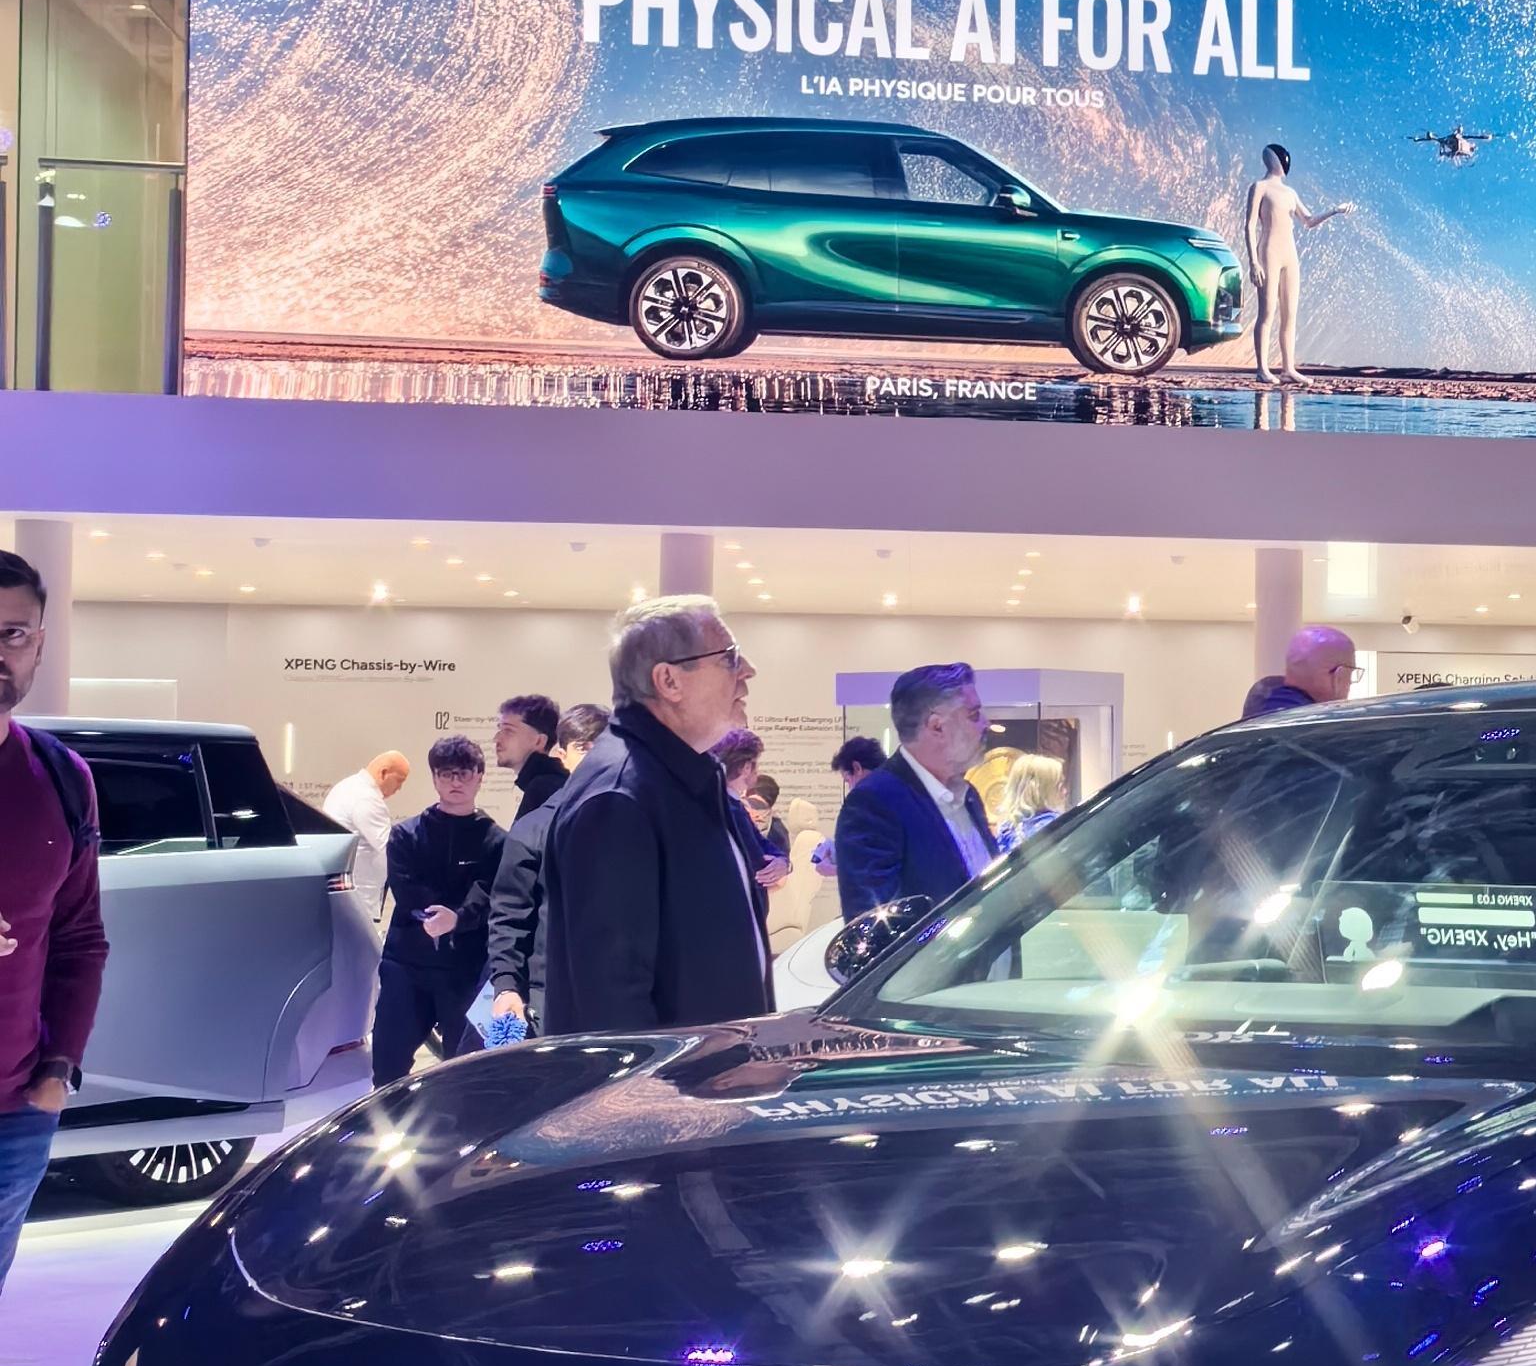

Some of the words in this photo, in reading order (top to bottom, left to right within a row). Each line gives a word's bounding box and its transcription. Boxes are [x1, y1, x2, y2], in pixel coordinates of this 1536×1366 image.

[849, 76, 966, 102] PHYSIQUE
[973, 83, 1037, 105] POUR
[1041, 87, 1105, 109] TOUS
[866, 376, 938, 400] PARIS,
[945, 379, 1037, 401] FRANCE
[284, 658, 336, 671] XPENG
[340, 658, 456, 674] Chassis-by-Wire
[1397, 673, 1442, 684] XPENG
[435, 711, 450, 730] 02
